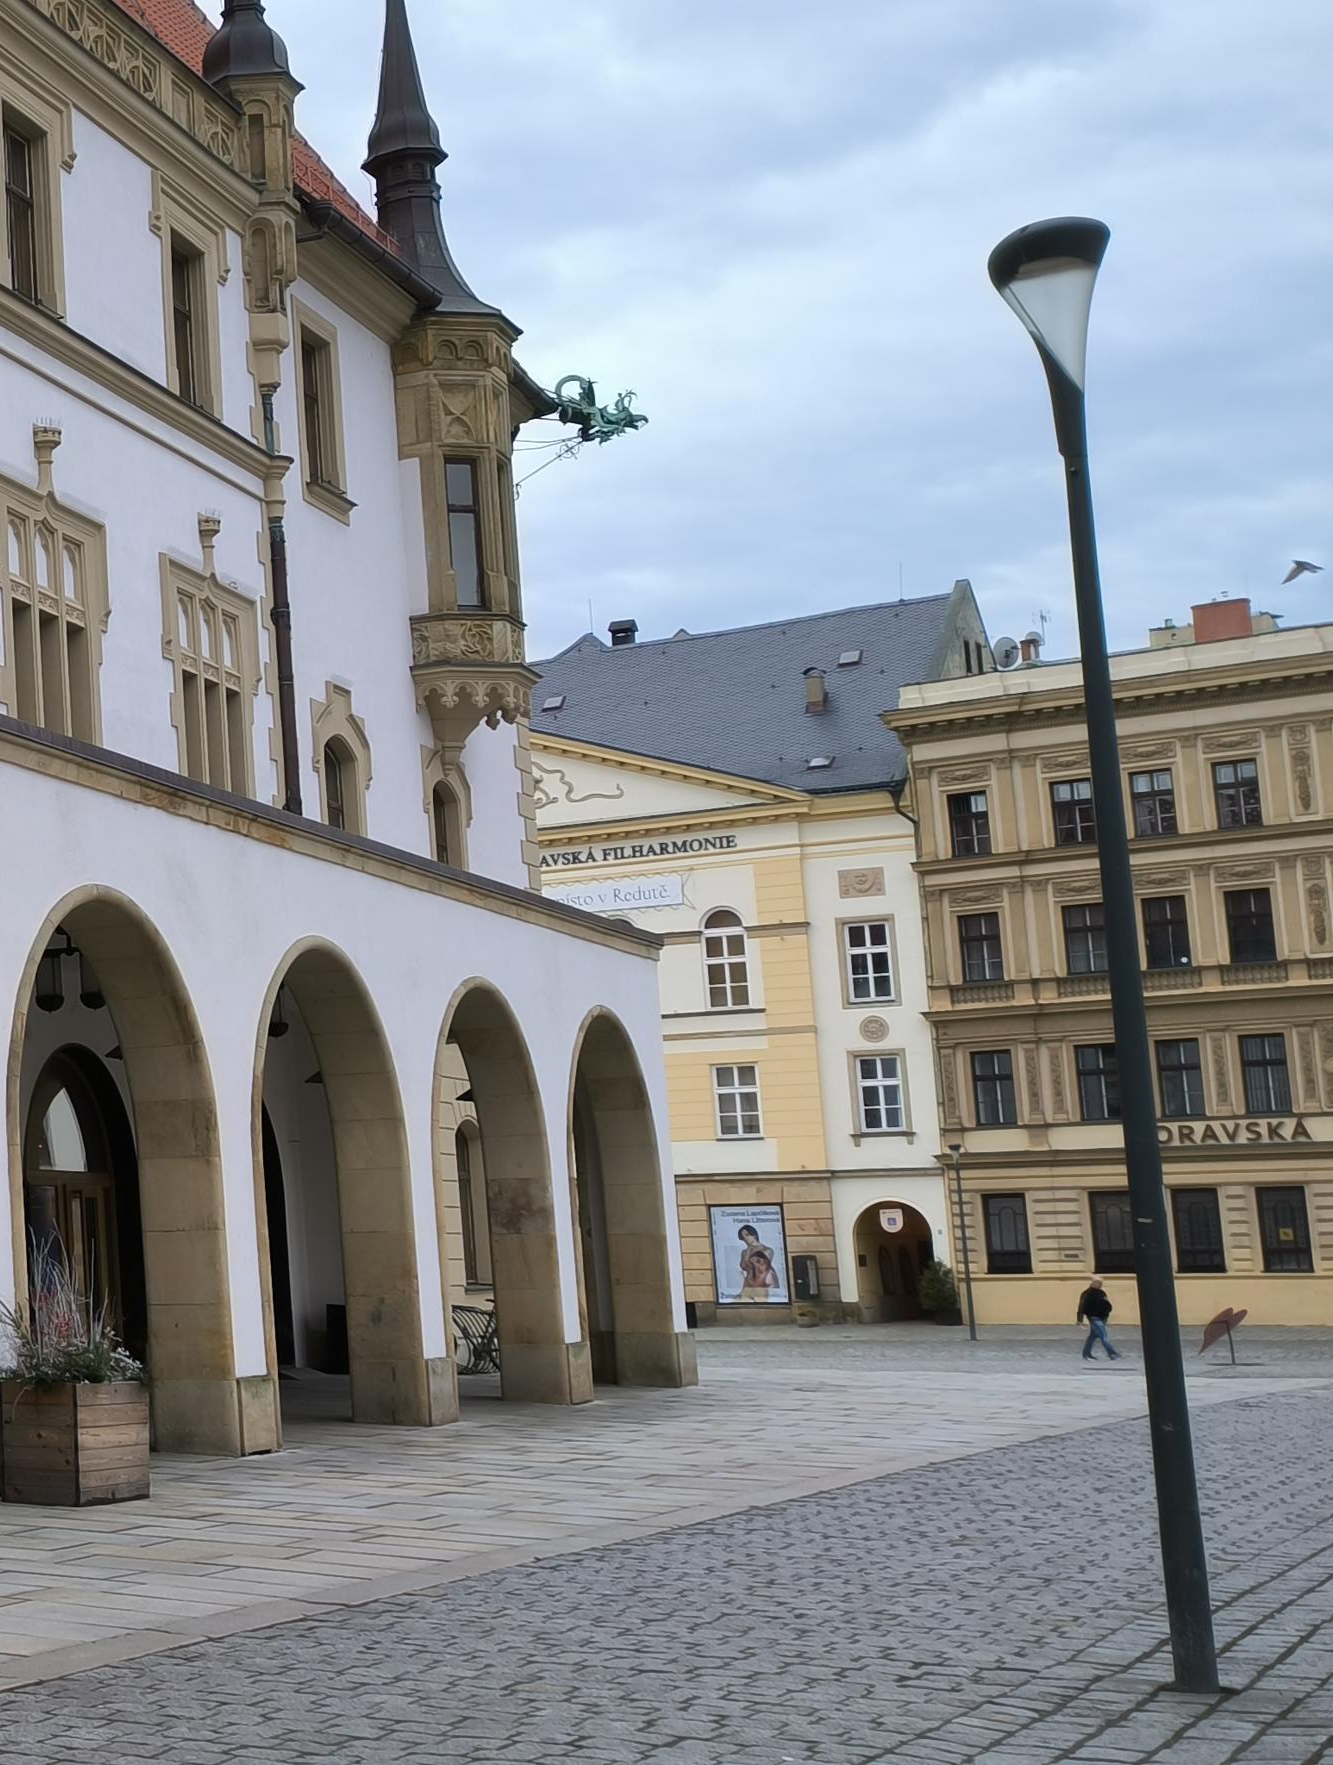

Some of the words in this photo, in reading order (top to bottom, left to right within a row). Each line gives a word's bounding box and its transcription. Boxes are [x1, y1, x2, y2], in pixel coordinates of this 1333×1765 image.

[601, 835, 738, 862] FILHARMONIE
[597, 894, 608, 904] v
[612, 885, 671, 904] Redutě
